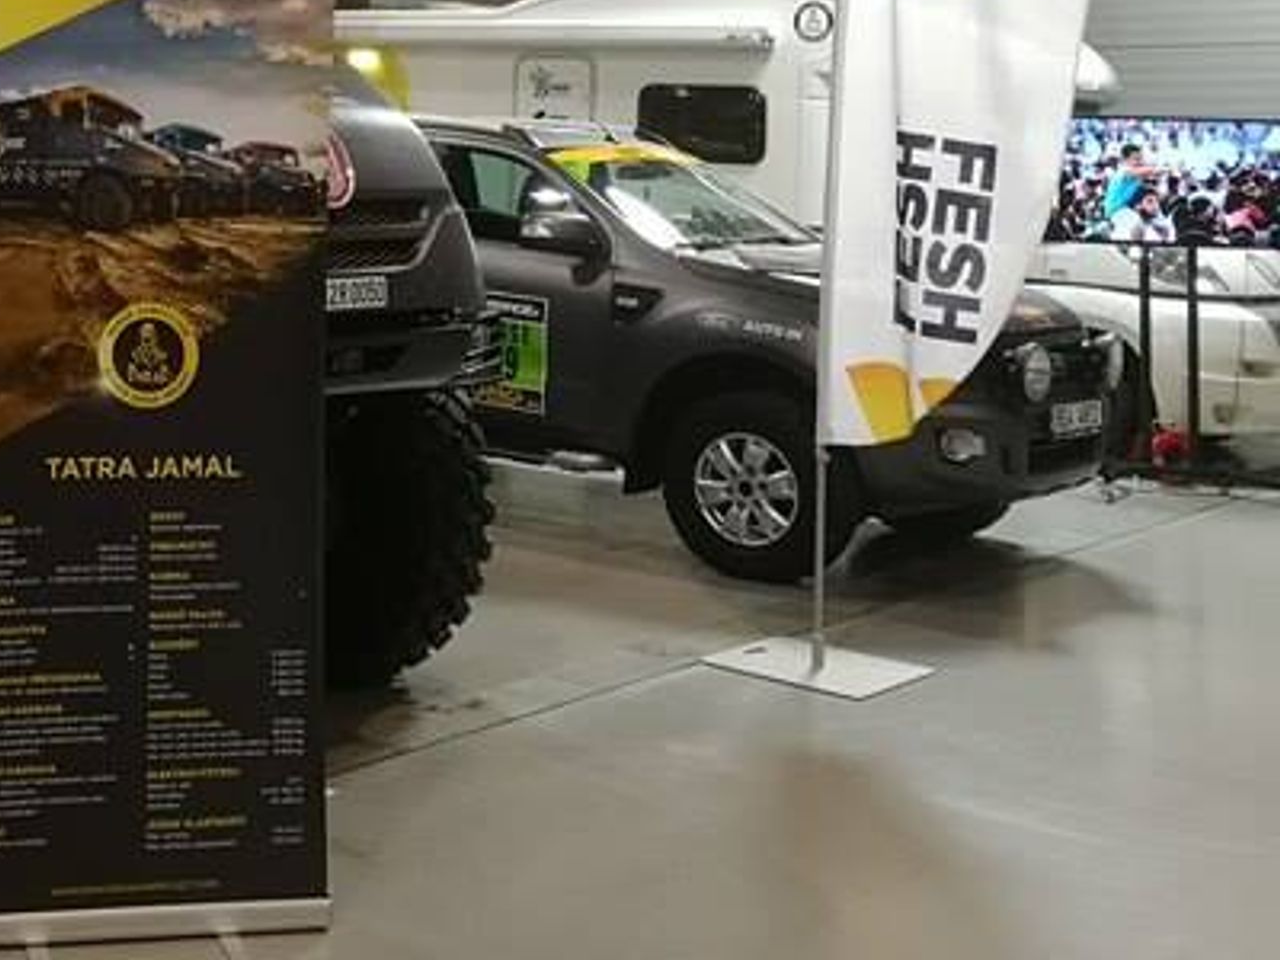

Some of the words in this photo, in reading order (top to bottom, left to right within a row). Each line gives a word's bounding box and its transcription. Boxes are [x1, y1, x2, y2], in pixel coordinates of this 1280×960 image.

[920, 137, 997, 344] FESH
[46, 457, 137, 478] TATRA
[146, 455, 242, 478] JAMAL
